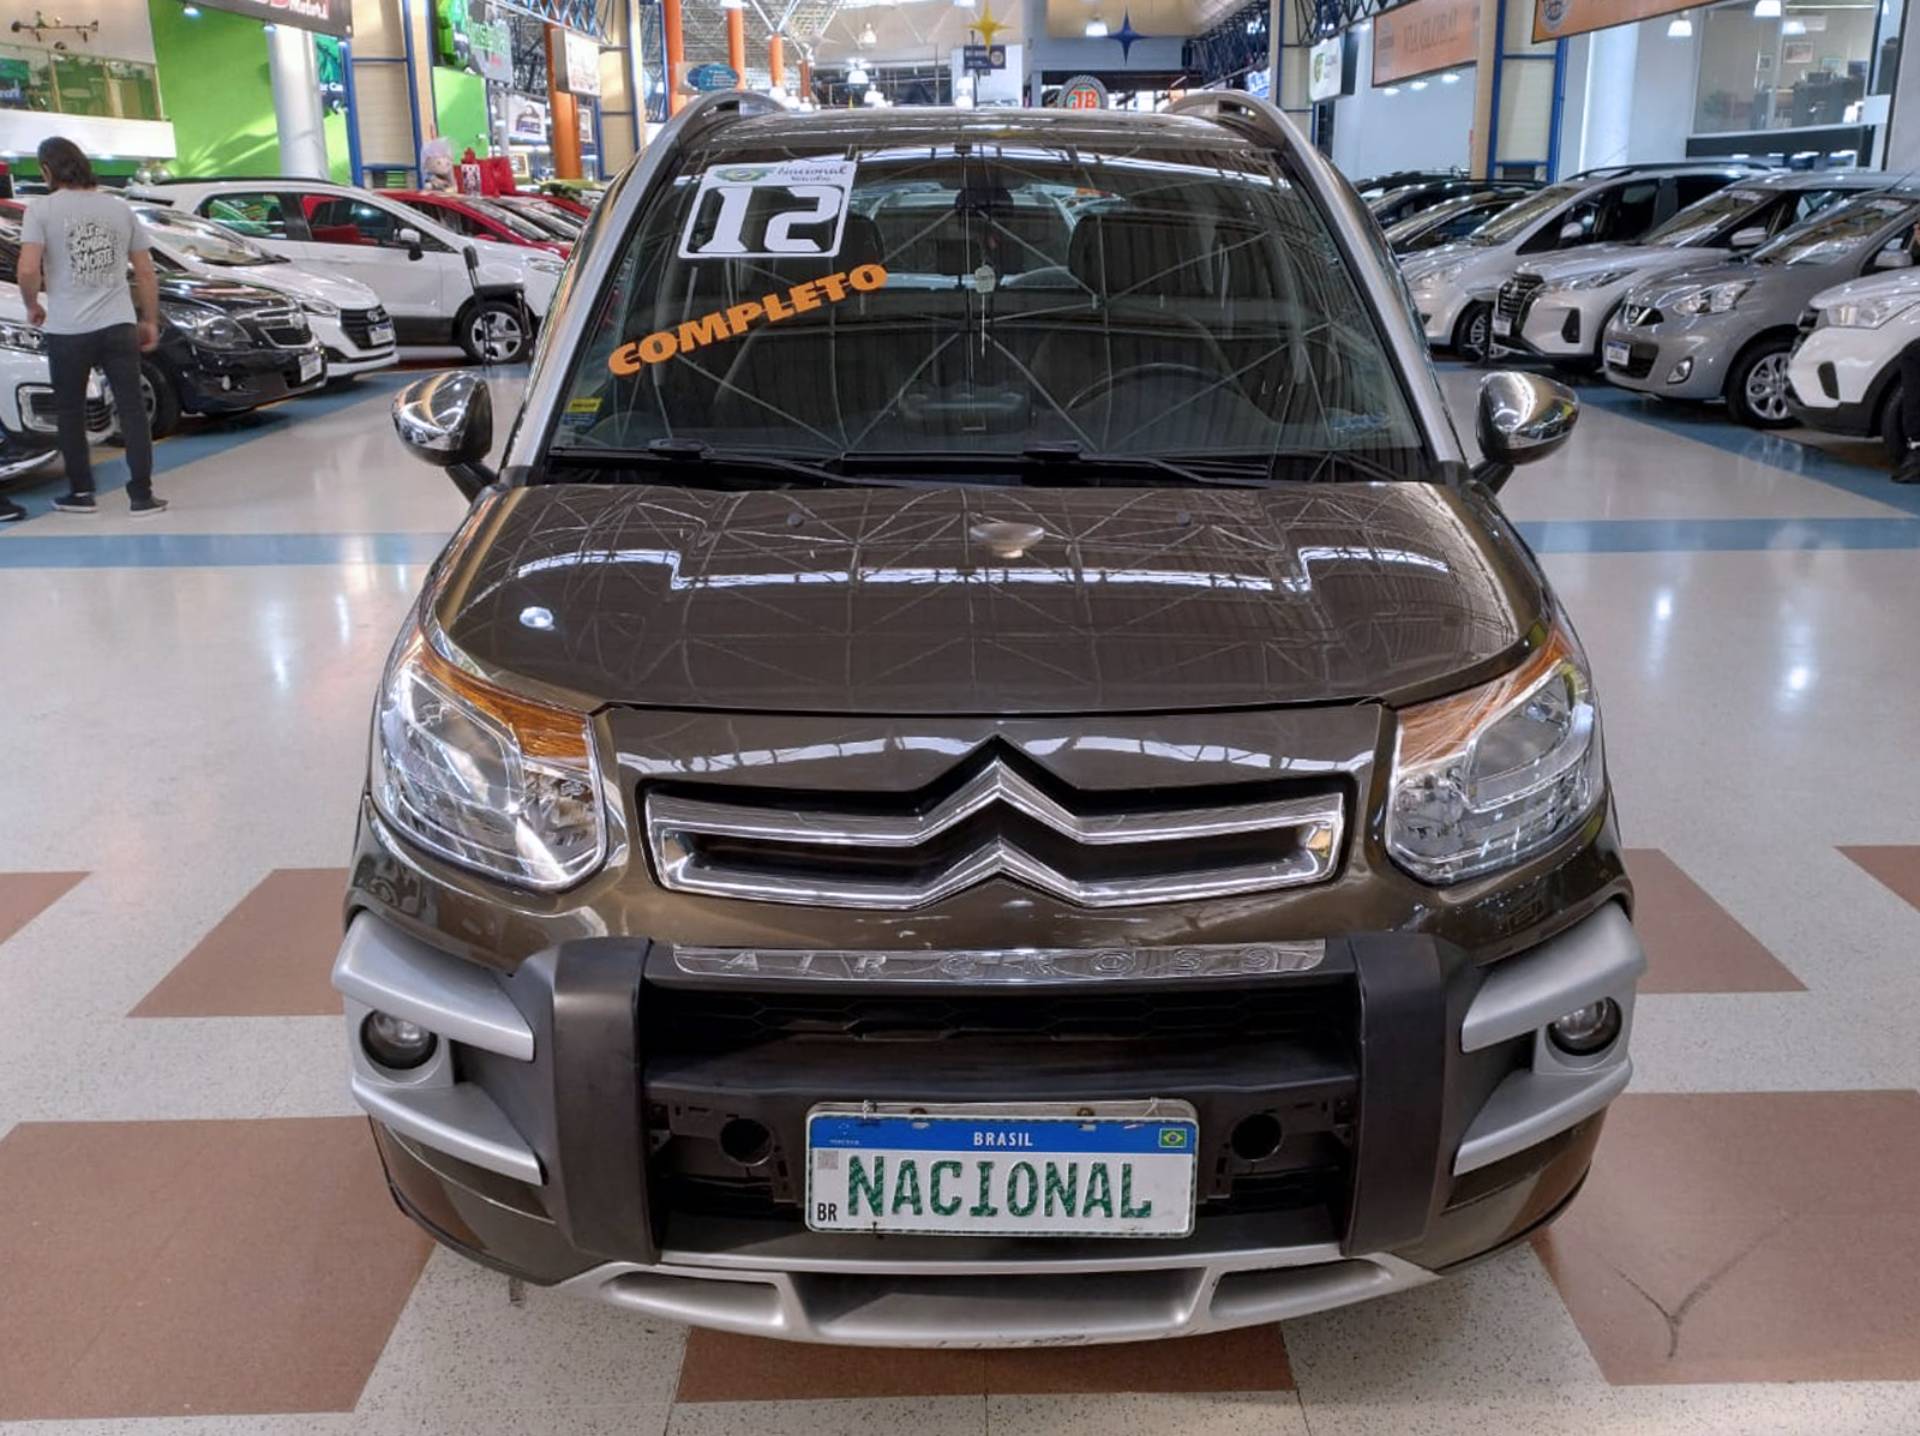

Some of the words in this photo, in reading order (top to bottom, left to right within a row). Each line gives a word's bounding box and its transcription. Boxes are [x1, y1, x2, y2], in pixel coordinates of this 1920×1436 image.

[696, 186, 842, 253] 12
[608, 263, 888, 376] COMPLETO
[973, 1131, 1033, 1147] BRASIL
[817, 1202, 837, 1221] BR
[848, 1155, 1152, 1218] NACIONAL
